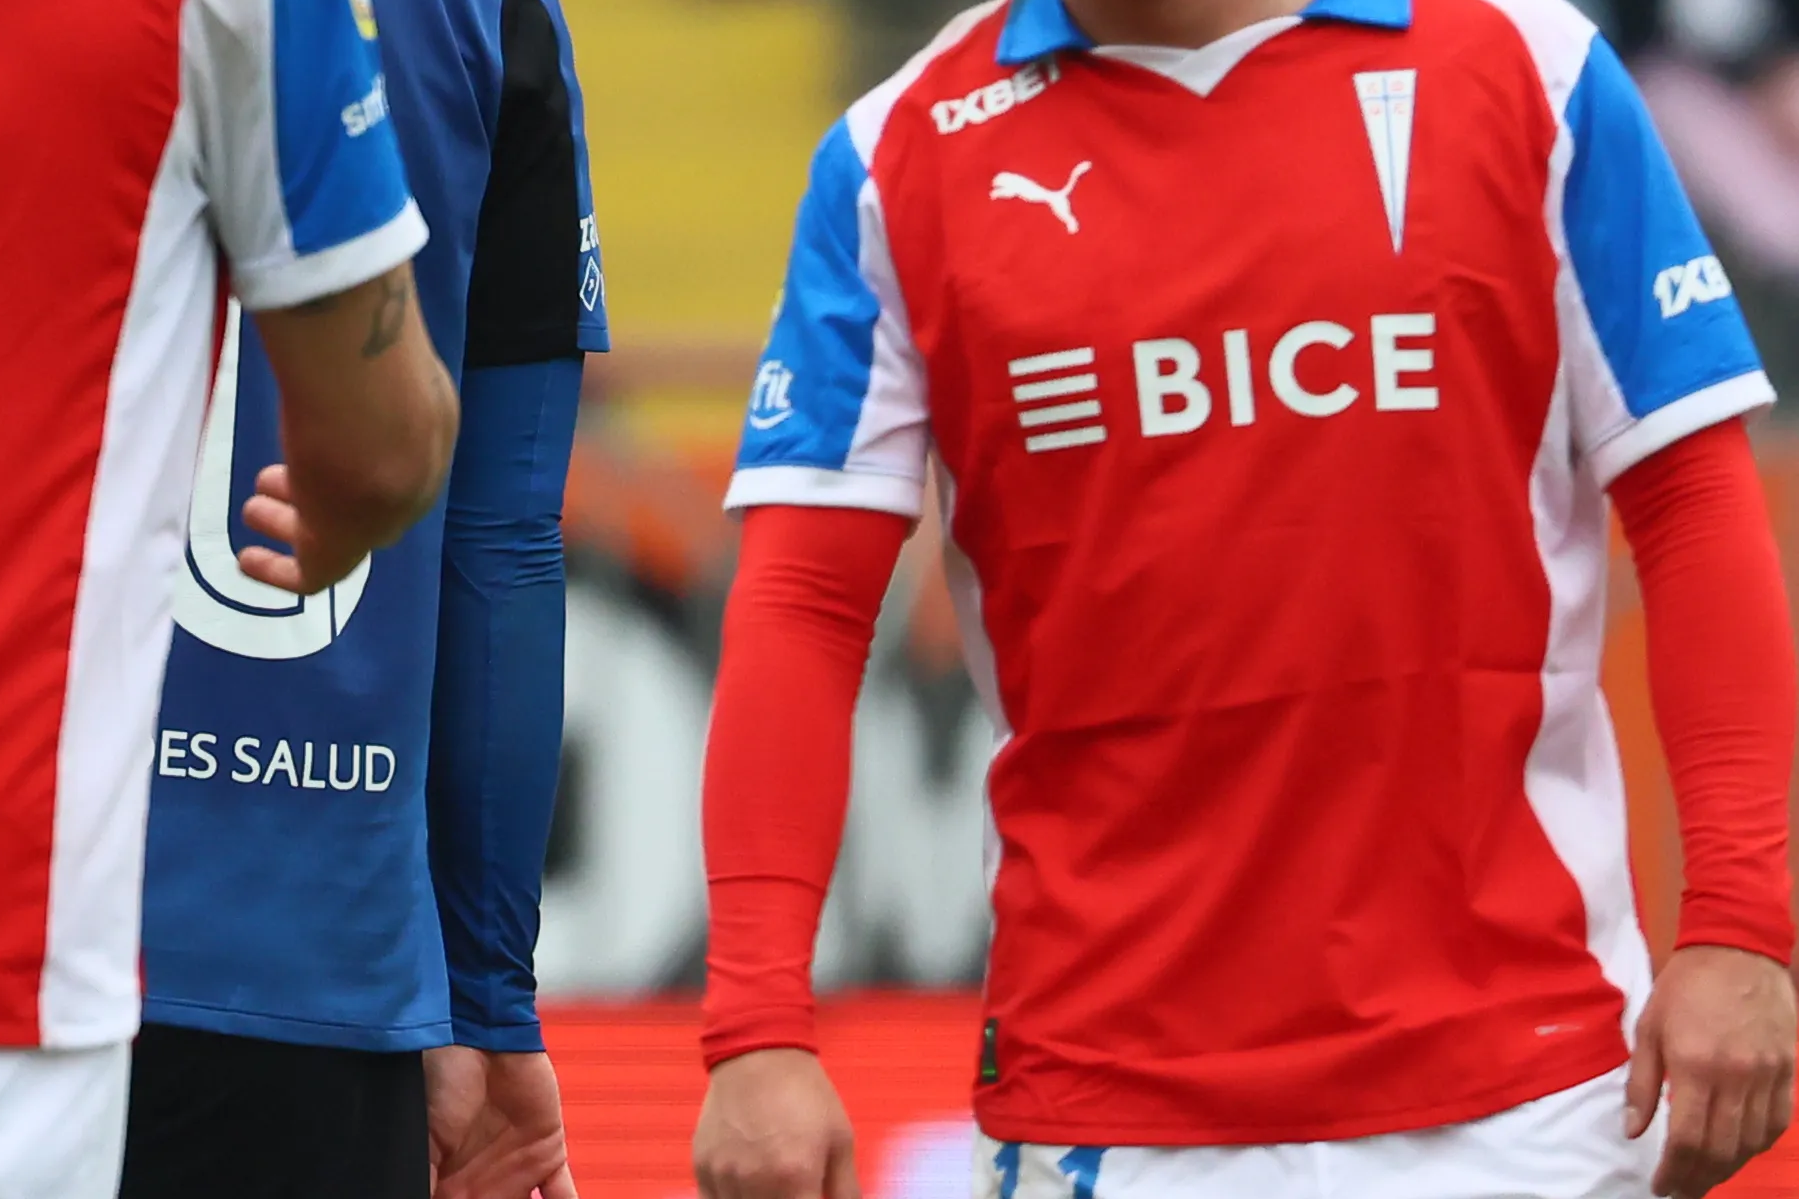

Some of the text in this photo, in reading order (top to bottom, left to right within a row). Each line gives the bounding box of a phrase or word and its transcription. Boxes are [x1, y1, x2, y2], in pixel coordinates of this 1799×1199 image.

[1132, 312, 1439, 437] BICE
[150, 728, 397, 793] ES SALUD
